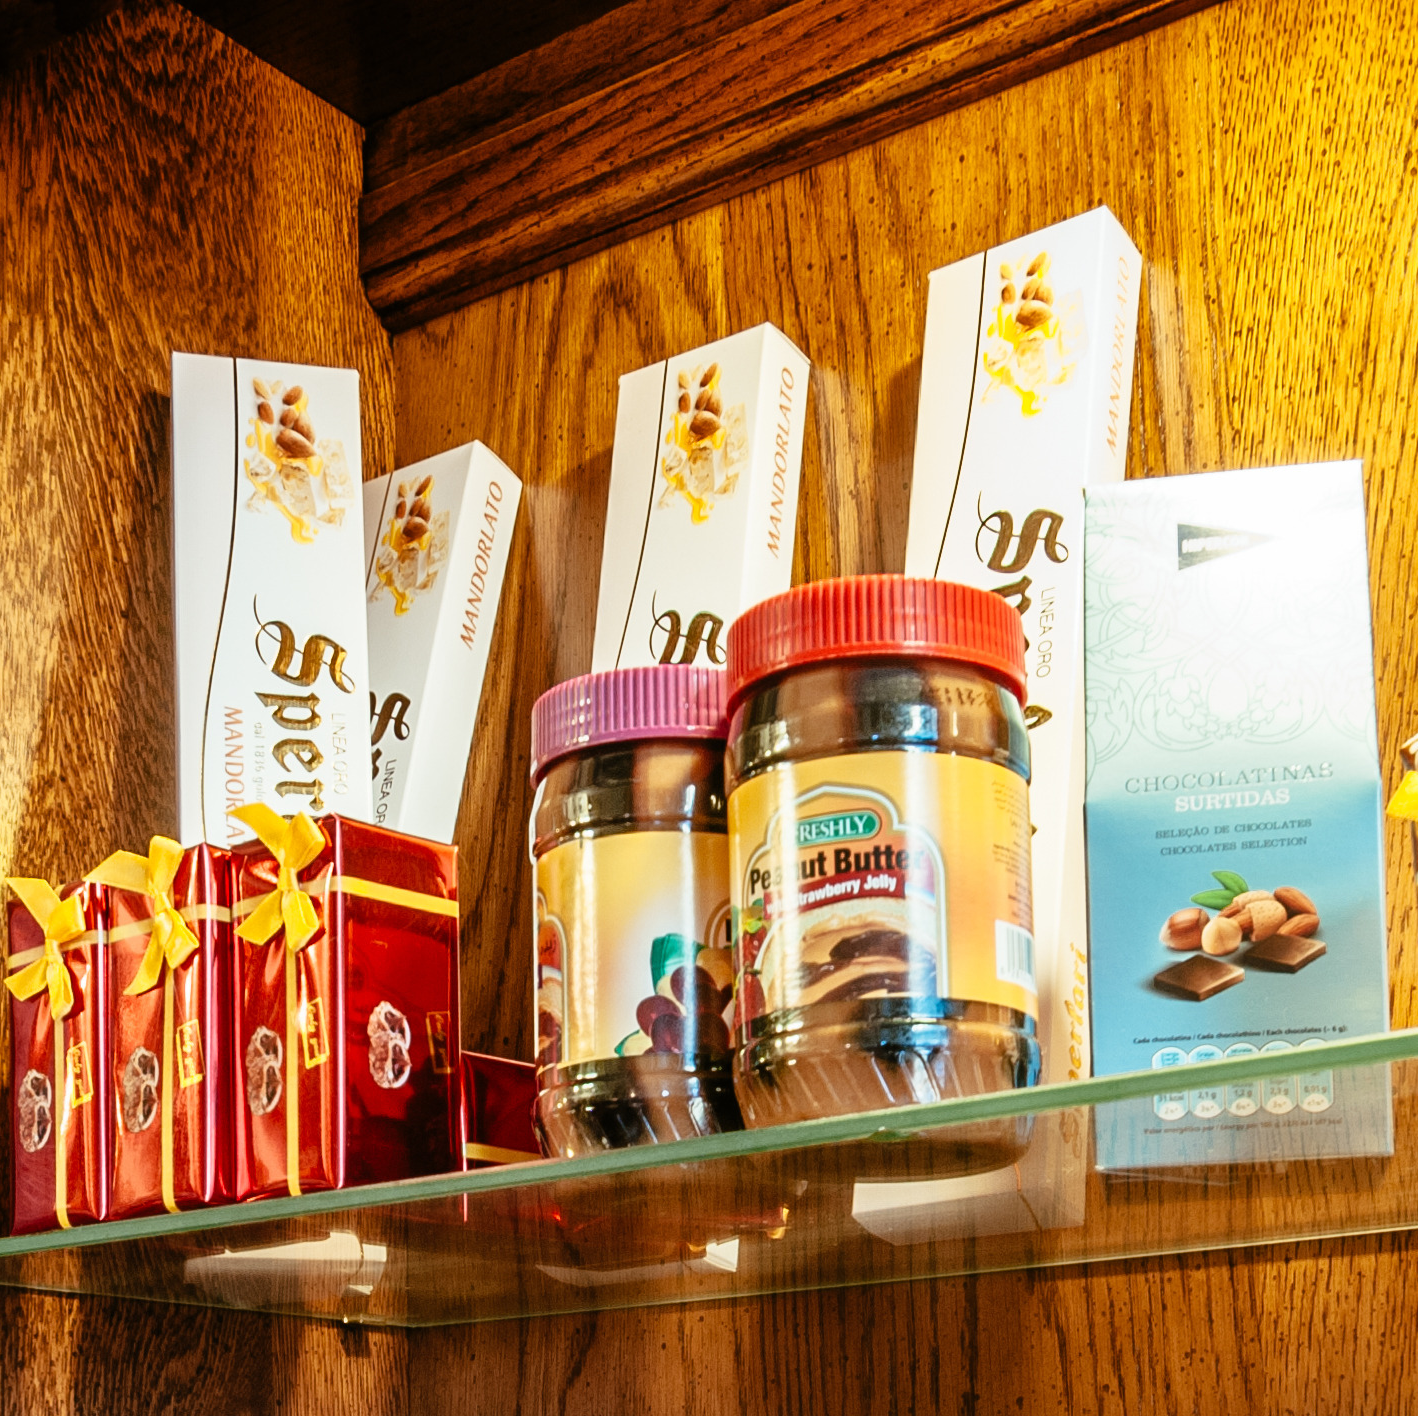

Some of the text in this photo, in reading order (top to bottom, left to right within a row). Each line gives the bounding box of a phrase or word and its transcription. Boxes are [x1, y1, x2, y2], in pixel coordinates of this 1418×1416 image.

[1105, 256, 1130, 457] MANDORLATO
[767, 367, 795, 559] MANDORLATO
[460, 480, 504, 651] MANDORLATO
[1034, 587, 1057, 678] LINEA ORO
[253, 593, 356, 824] Sper
[224, 705, 247, 850] MANDORLA
[331, 712, 349, 795] LINEA ORO
[1125, 762, 1334, 794] CHOCOLATINAS
[374, 758, 397, 825] LINEA OR
[1175, 788, 1291, 813] SURTIDAS
[794, 813, 869, 843] RESHLY
[1155, 818, 1313, 839] SELEÇÃO DE CHOCOLATES
[1160, 836, 1308, 857] CHOCOLATES SELECTION
[750, 851, 827, 896] Peaut
[796, 878, 861, 907] trawberry
[863, 873, 897, 893] Jelly
